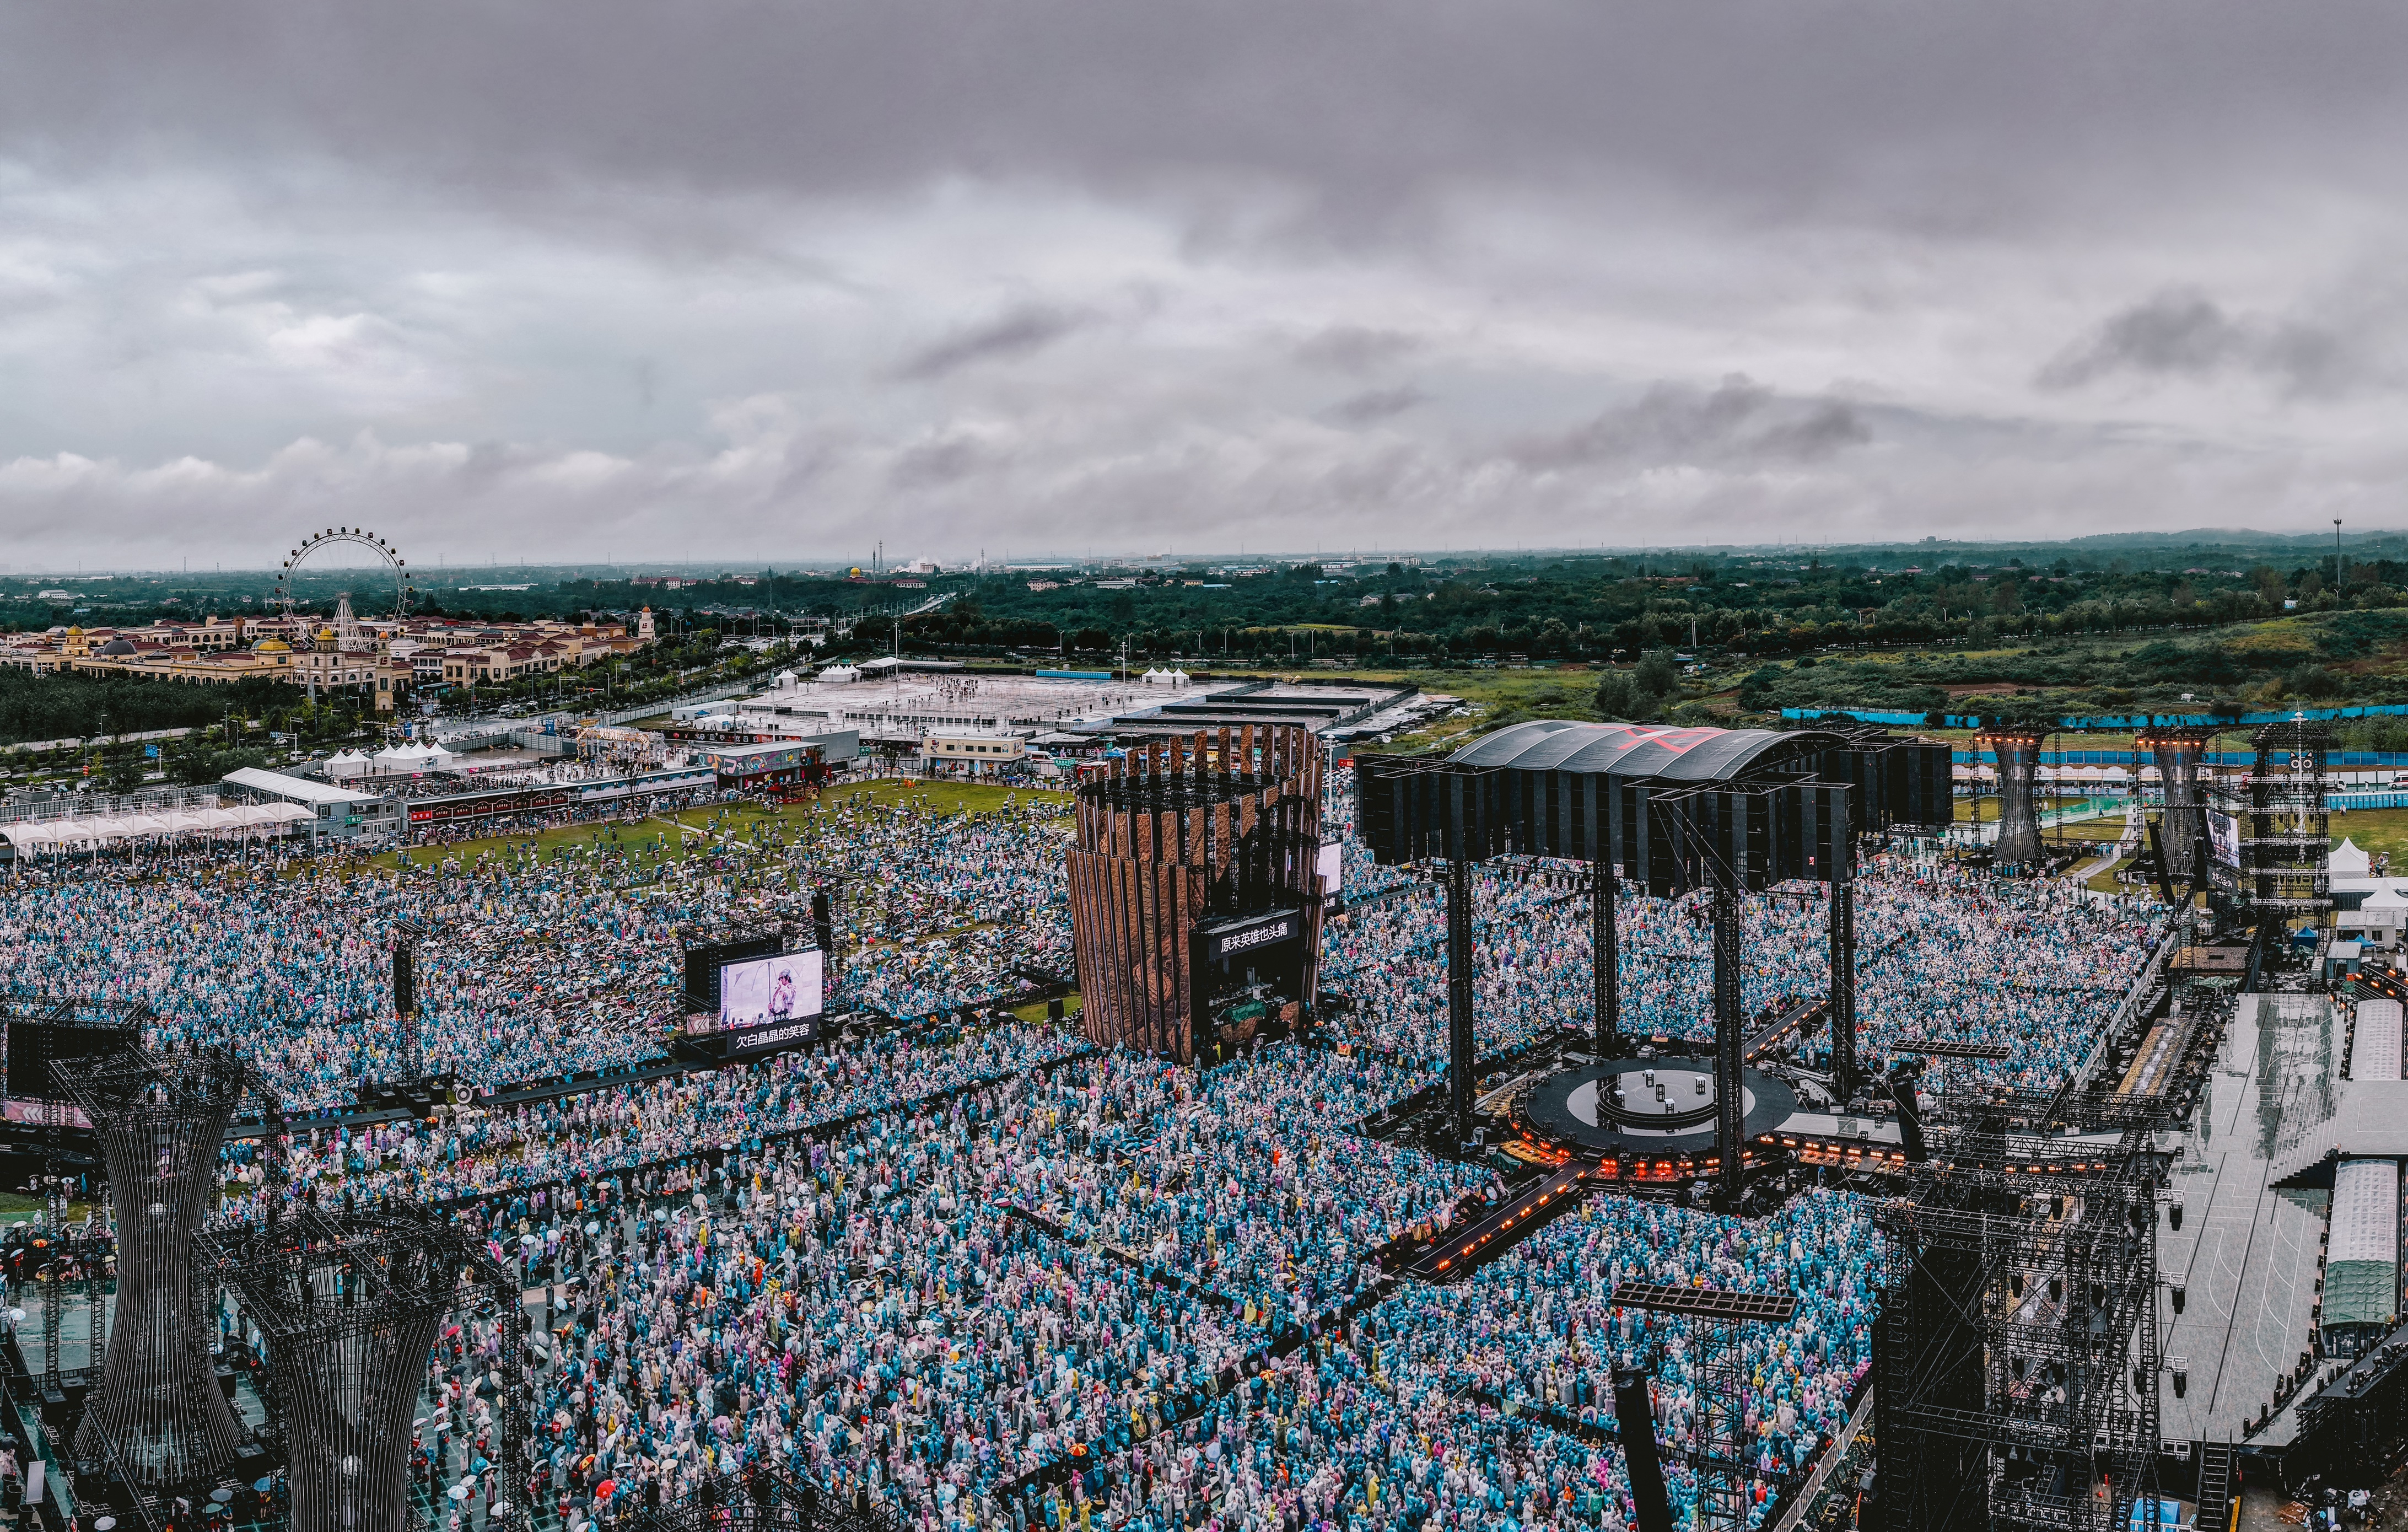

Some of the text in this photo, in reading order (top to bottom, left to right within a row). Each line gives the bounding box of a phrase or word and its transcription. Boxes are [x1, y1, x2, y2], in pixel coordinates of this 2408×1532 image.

[1220, 921, 1288, 953] 原来英雄也头痛
[736, 1023, 810, 1049] 欠白晶晶的笑容
